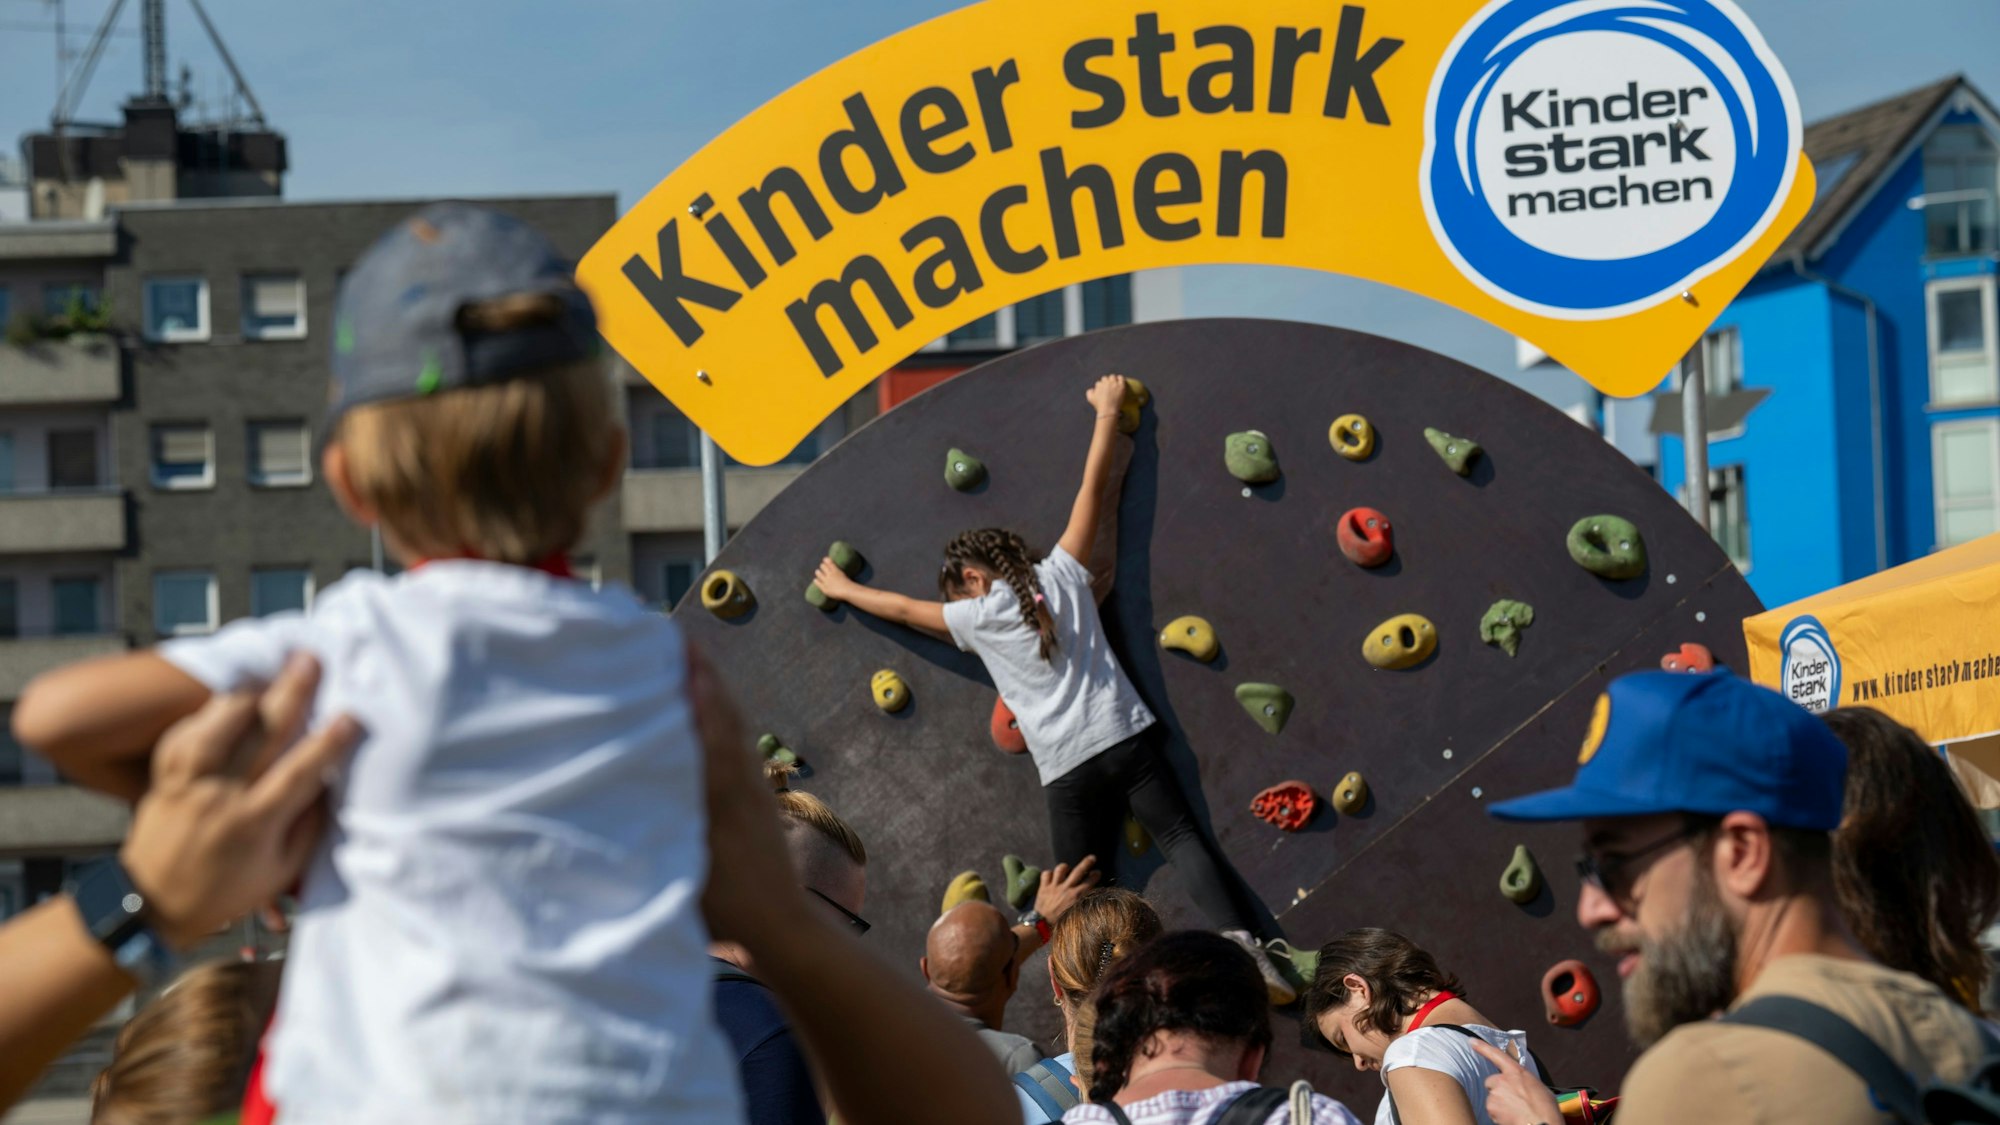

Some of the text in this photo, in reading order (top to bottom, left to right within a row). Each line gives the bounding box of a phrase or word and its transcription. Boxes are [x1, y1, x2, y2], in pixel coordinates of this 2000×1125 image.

[1502, 81, 1708, 132] Kinder
[1504, 120, 1713, 178] stark
[621, 4, 1405, 348] Kinder stark
[1508, 174, 1714, 217] machen
[784, 146, 1289, 379] machen
[1791, 658, 1828, 680] Kinder
[1792, 676, 1827, 699] stark
